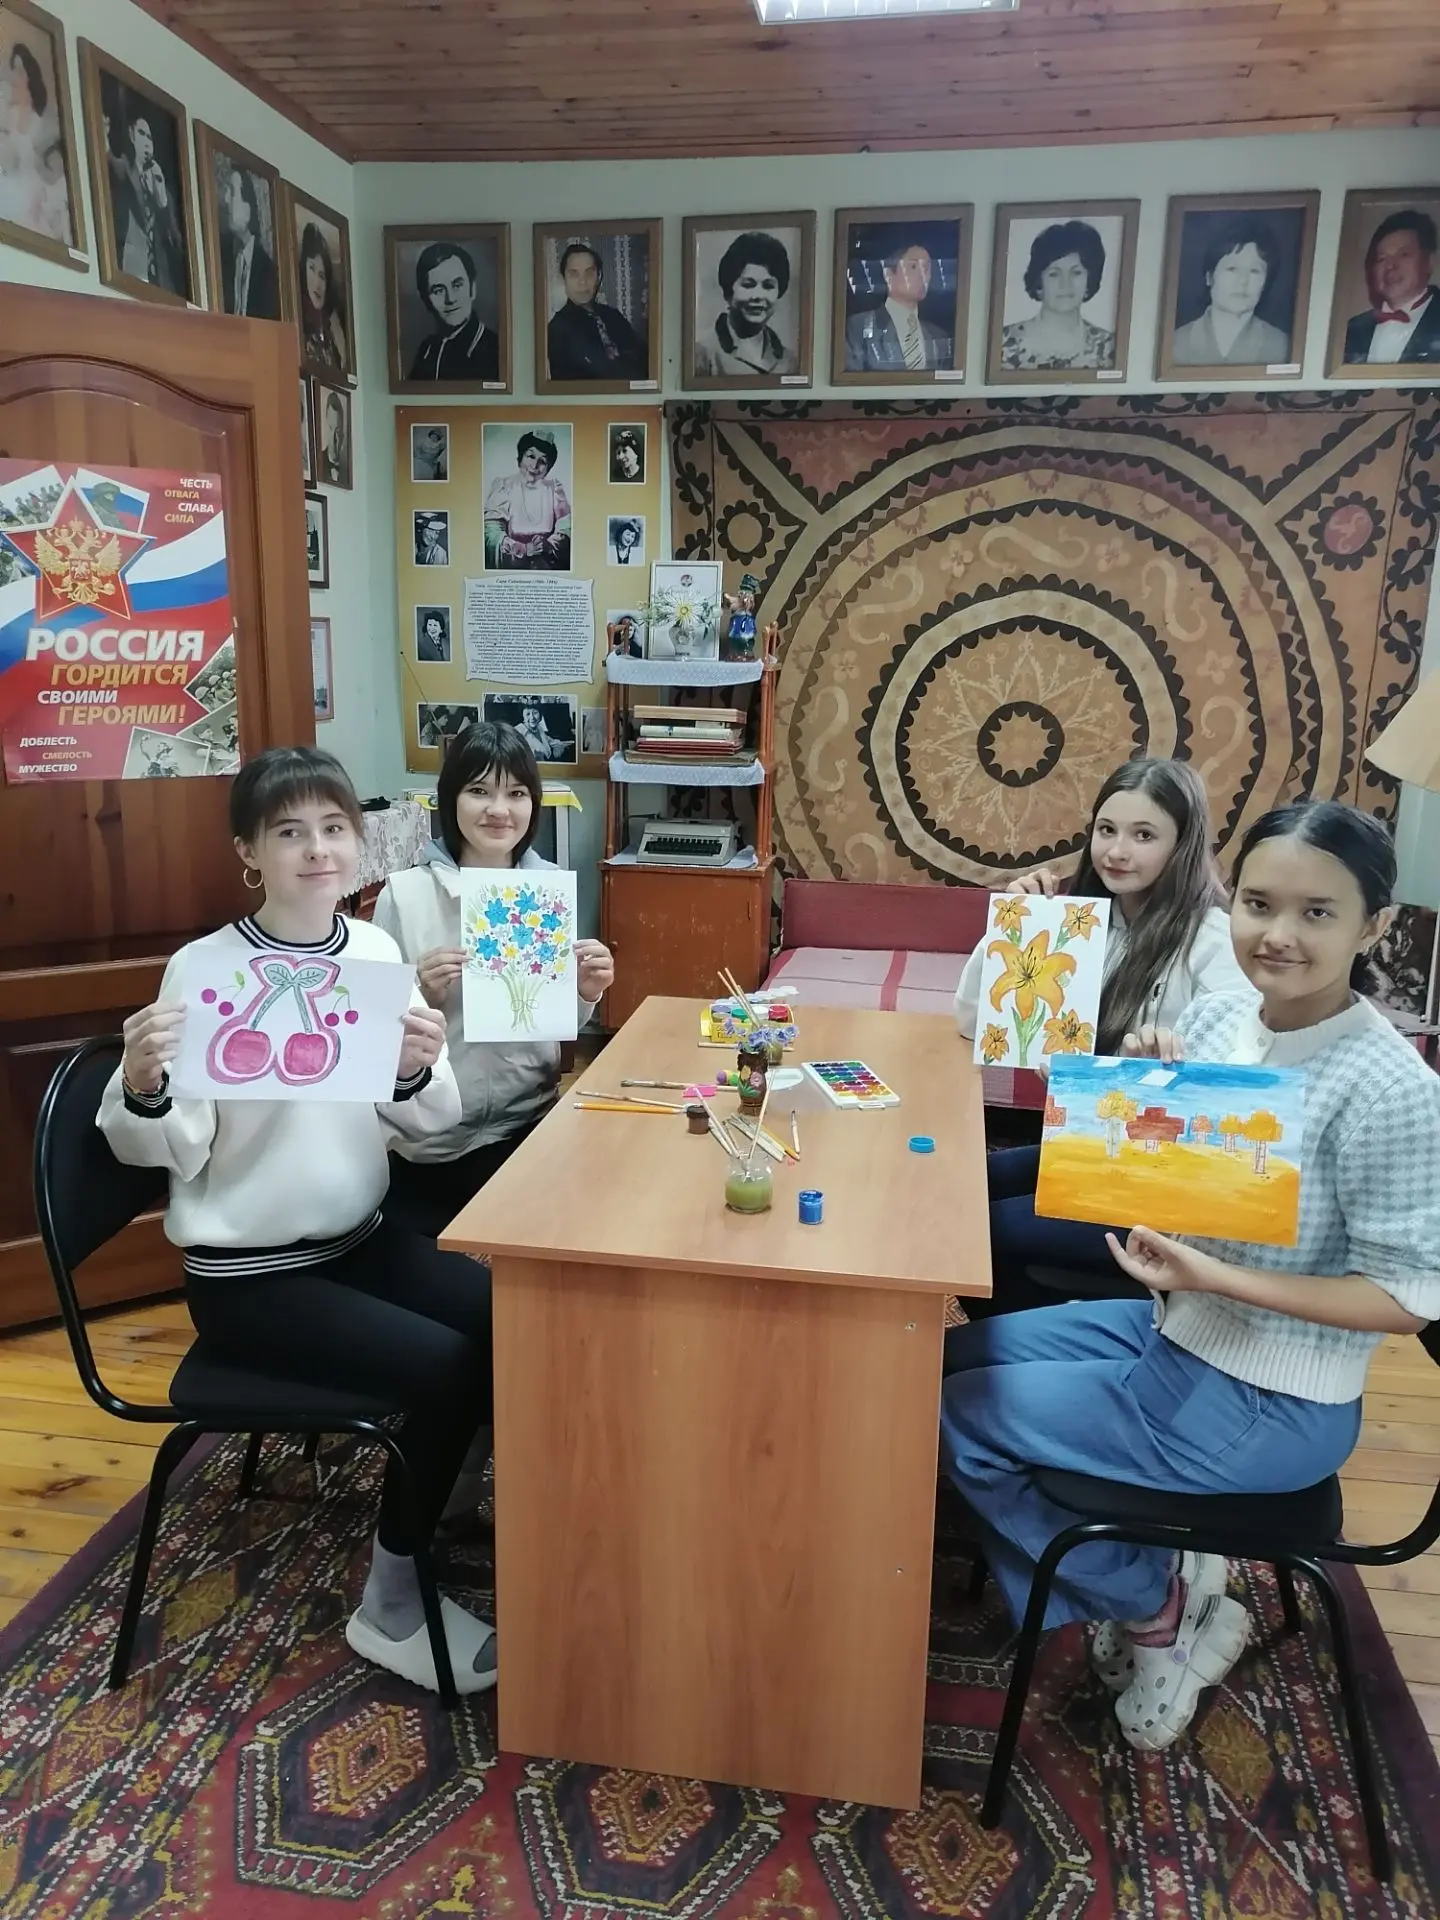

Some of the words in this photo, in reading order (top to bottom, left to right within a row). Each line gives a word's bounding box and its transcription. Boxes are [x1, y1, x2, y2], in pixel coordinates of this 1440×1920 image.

[180, 478, 213, 489] ЧЕСТЬ
[164, 489, 200, 499] ОТВАГА
[178, 502, 214, 513] СЛАВА
[164, 513, 195, 524] СИЛА
[25, 628, 205, 661] РОССИЯ
[51, 664, 189, 688] ГОРДИТСЯ
[37, 690, 119, 704] СВОИМИ
[58, 704, 186, 726] ГЕРОЯМИ!
[19, 736, 78, 747] ДОБЛЕСТЬ
[42, 751, 93, 760] СМЕЛОСТЬ
[18, 763, 77, 774] МУЖЕСТВО
